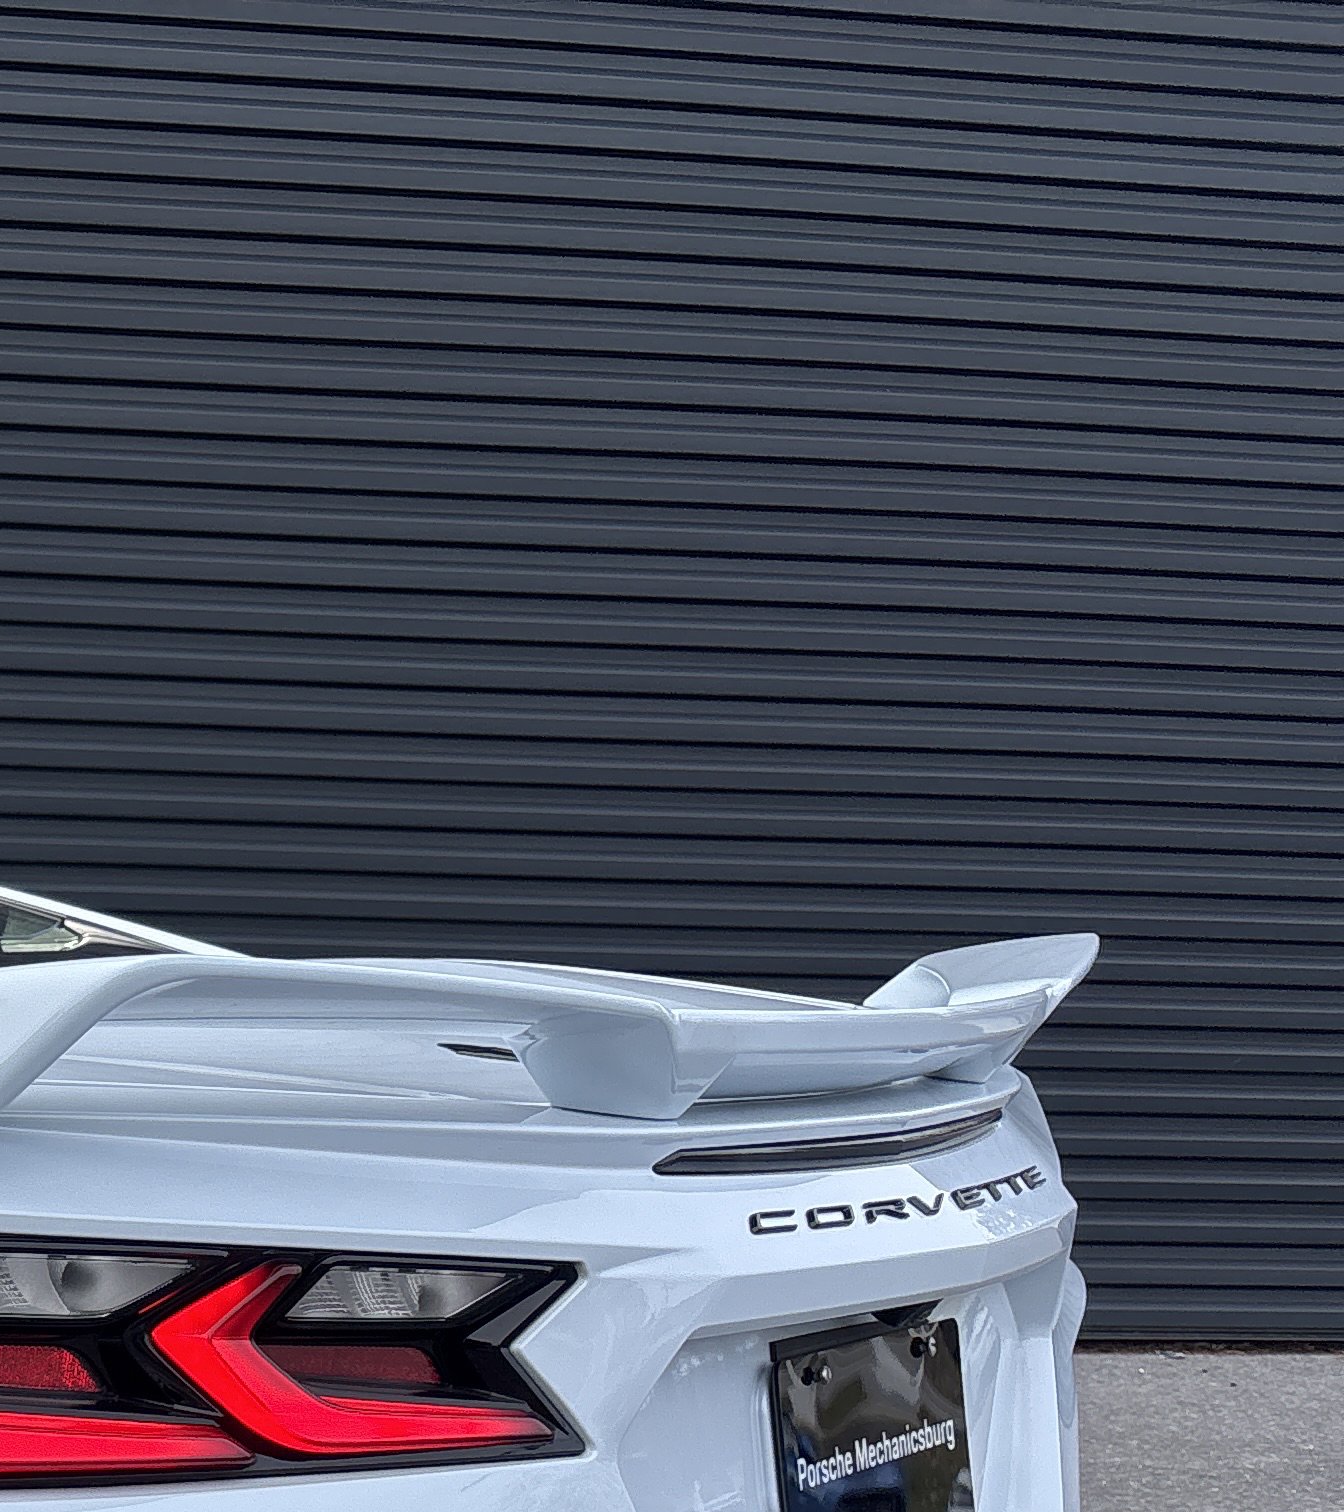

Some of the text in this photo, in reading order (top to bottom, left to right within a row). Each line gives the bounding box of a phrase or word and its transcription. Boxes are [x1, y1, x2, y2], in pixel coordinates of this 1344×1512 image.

[749, 1165, 1046, 1235] CORVETTE
[797, 1419, 955, 1491] Porsche Mechanicsburg
